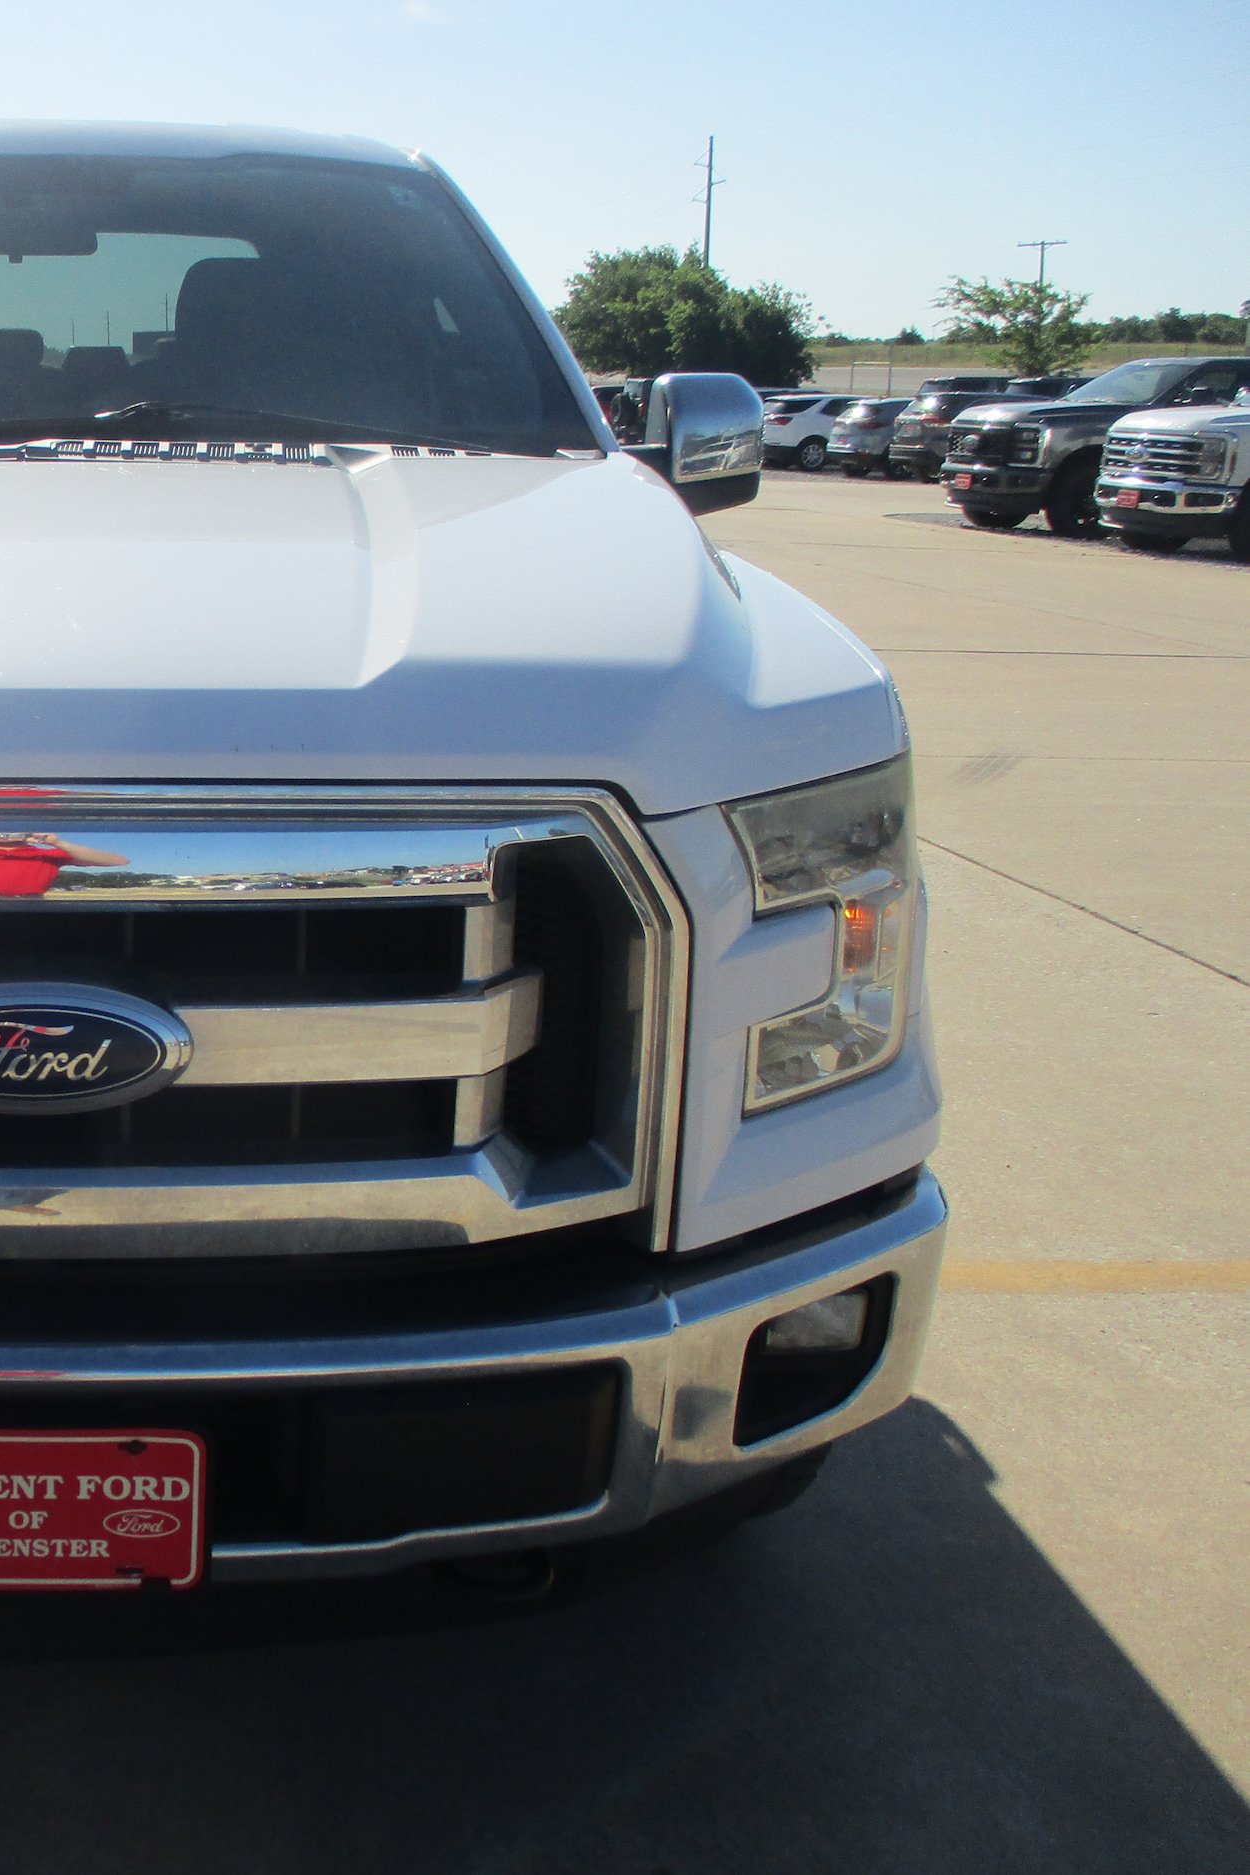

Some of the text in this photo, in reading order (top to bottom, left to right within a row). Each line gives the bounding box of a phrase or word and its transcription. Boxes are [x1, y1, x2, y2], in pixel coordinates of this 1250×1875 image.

[77, 1476, 191, 1501] FORD
[8, 1511, 48, 1530] OF
[116, 1514, 164, 1533] Ford
